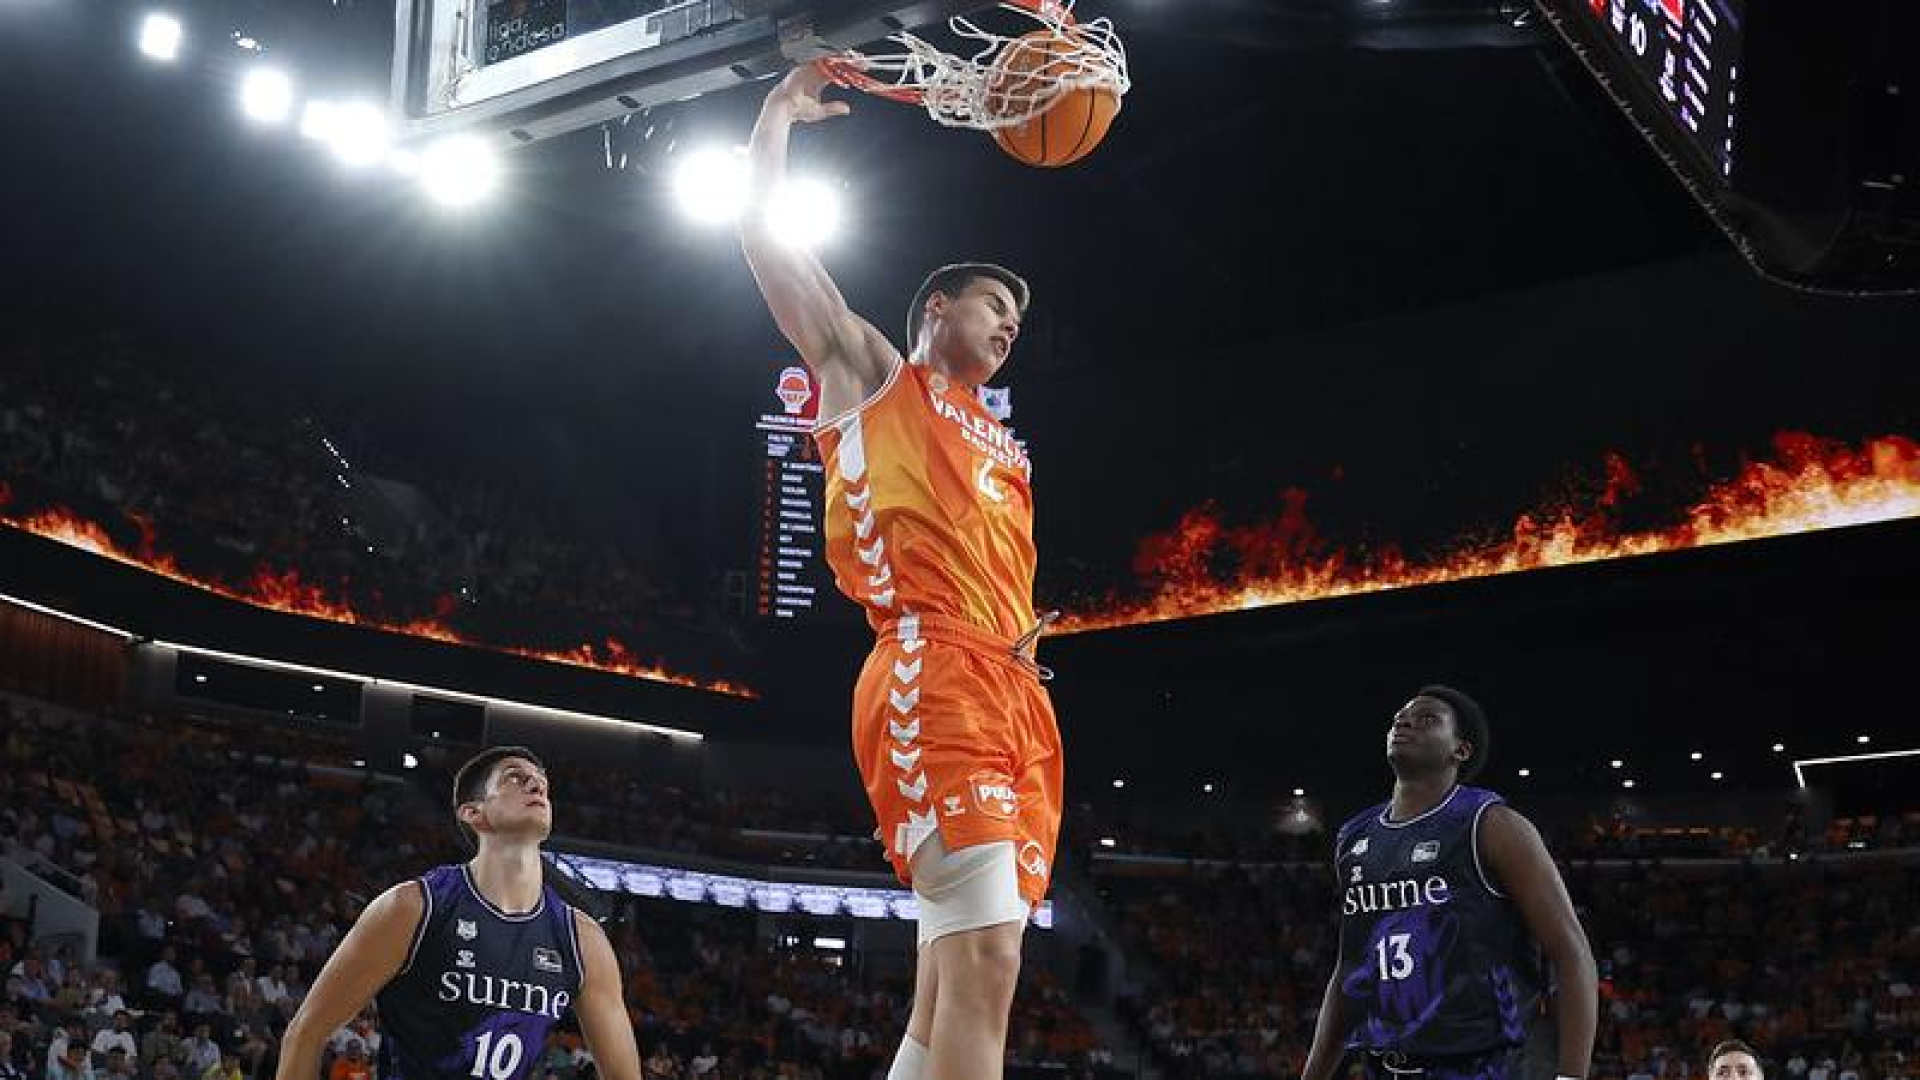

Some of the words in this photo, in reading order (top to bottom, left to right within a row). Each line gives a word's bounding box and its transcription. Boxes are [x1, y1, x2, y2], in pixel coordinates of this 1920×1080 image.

[1343, 875, 1448, 915] surne
[1376, 932, 1415, 980] 13
[438, 970, 570, 1020] surne
[470, 1031, 524, 1080] 10
